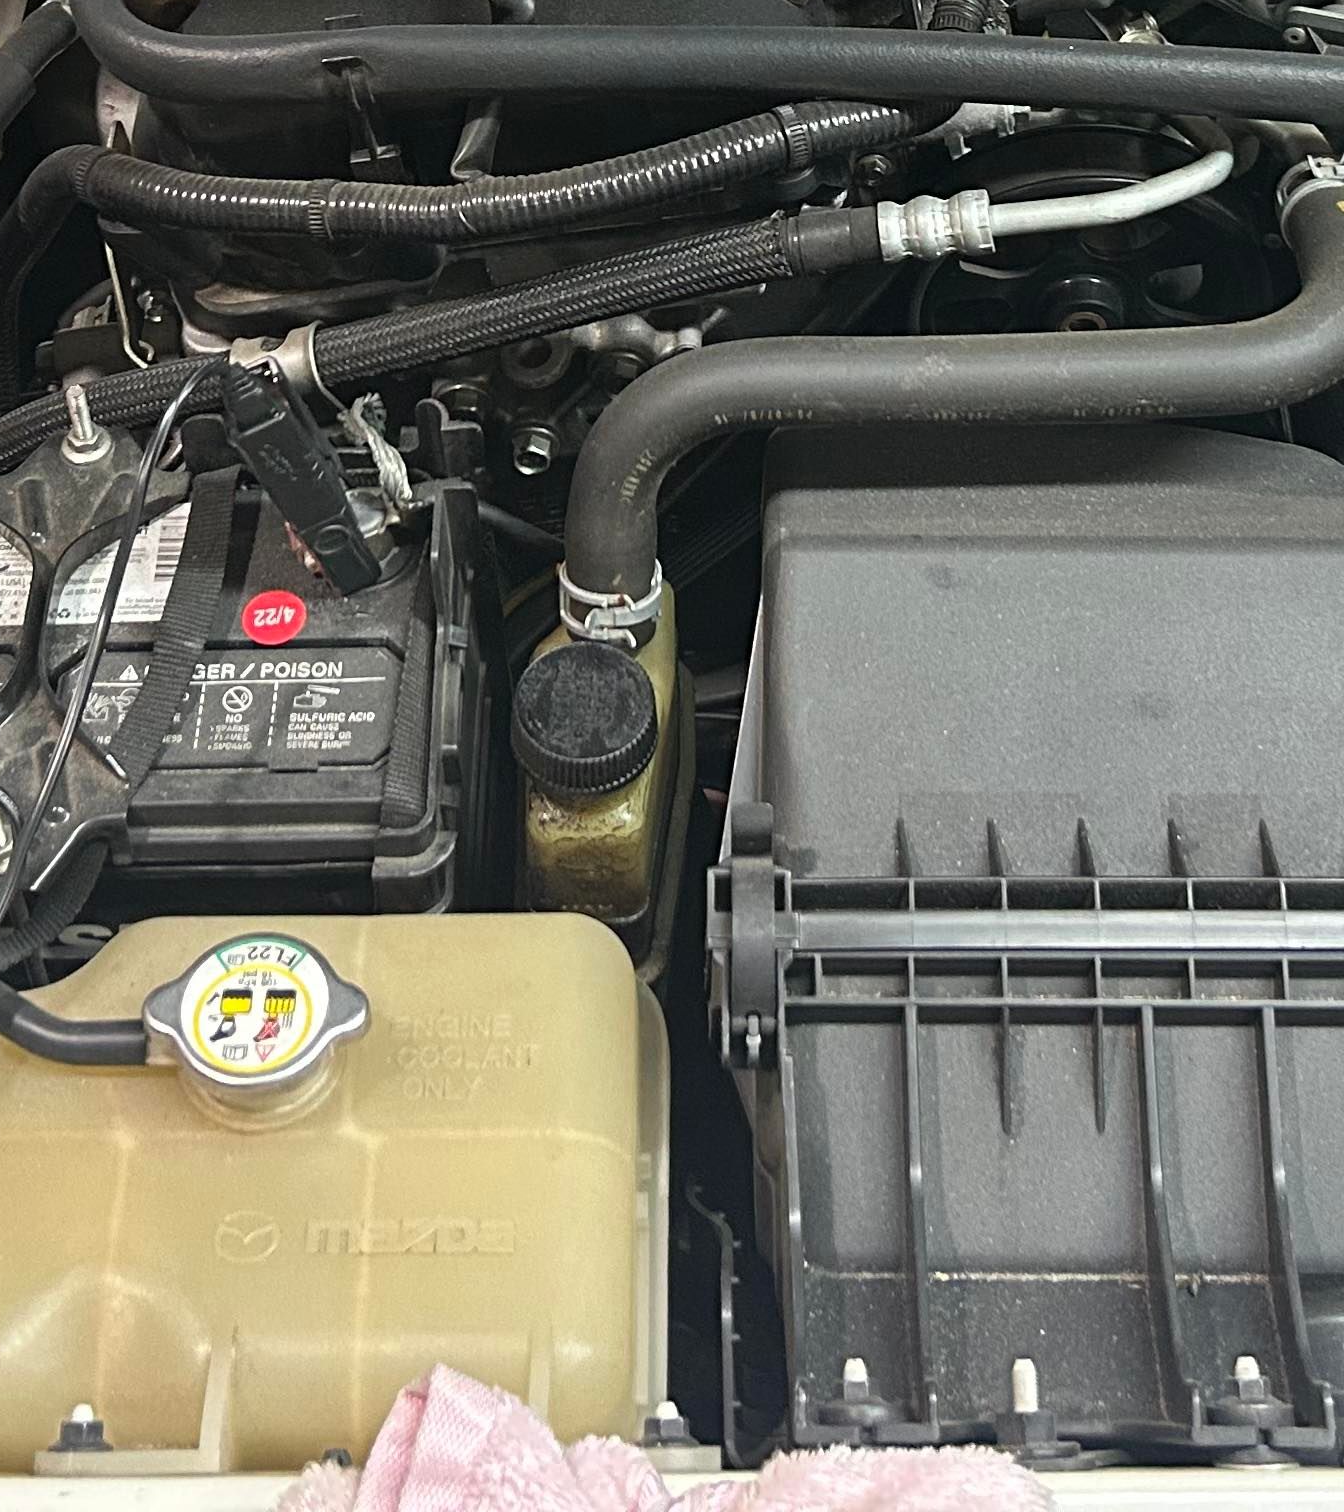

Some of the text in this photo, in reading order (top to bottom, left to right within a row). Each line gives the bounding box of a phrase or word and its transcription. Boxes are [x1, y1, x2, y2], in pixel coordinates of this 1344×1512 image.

[253, 605, 296, 627] 4/22
[259, 661, 343, 678] POISON
[225, 714, 243, 723] NO
[289, 711, 375, 722] SULFURIC ACID
[246, 944, 298, 967] FL22
[390, 1014, 513, 1037] ENGINE
[397, 1043, 537, 1069] COOLANT
[403, 1076, 483, 1101] ONLY
